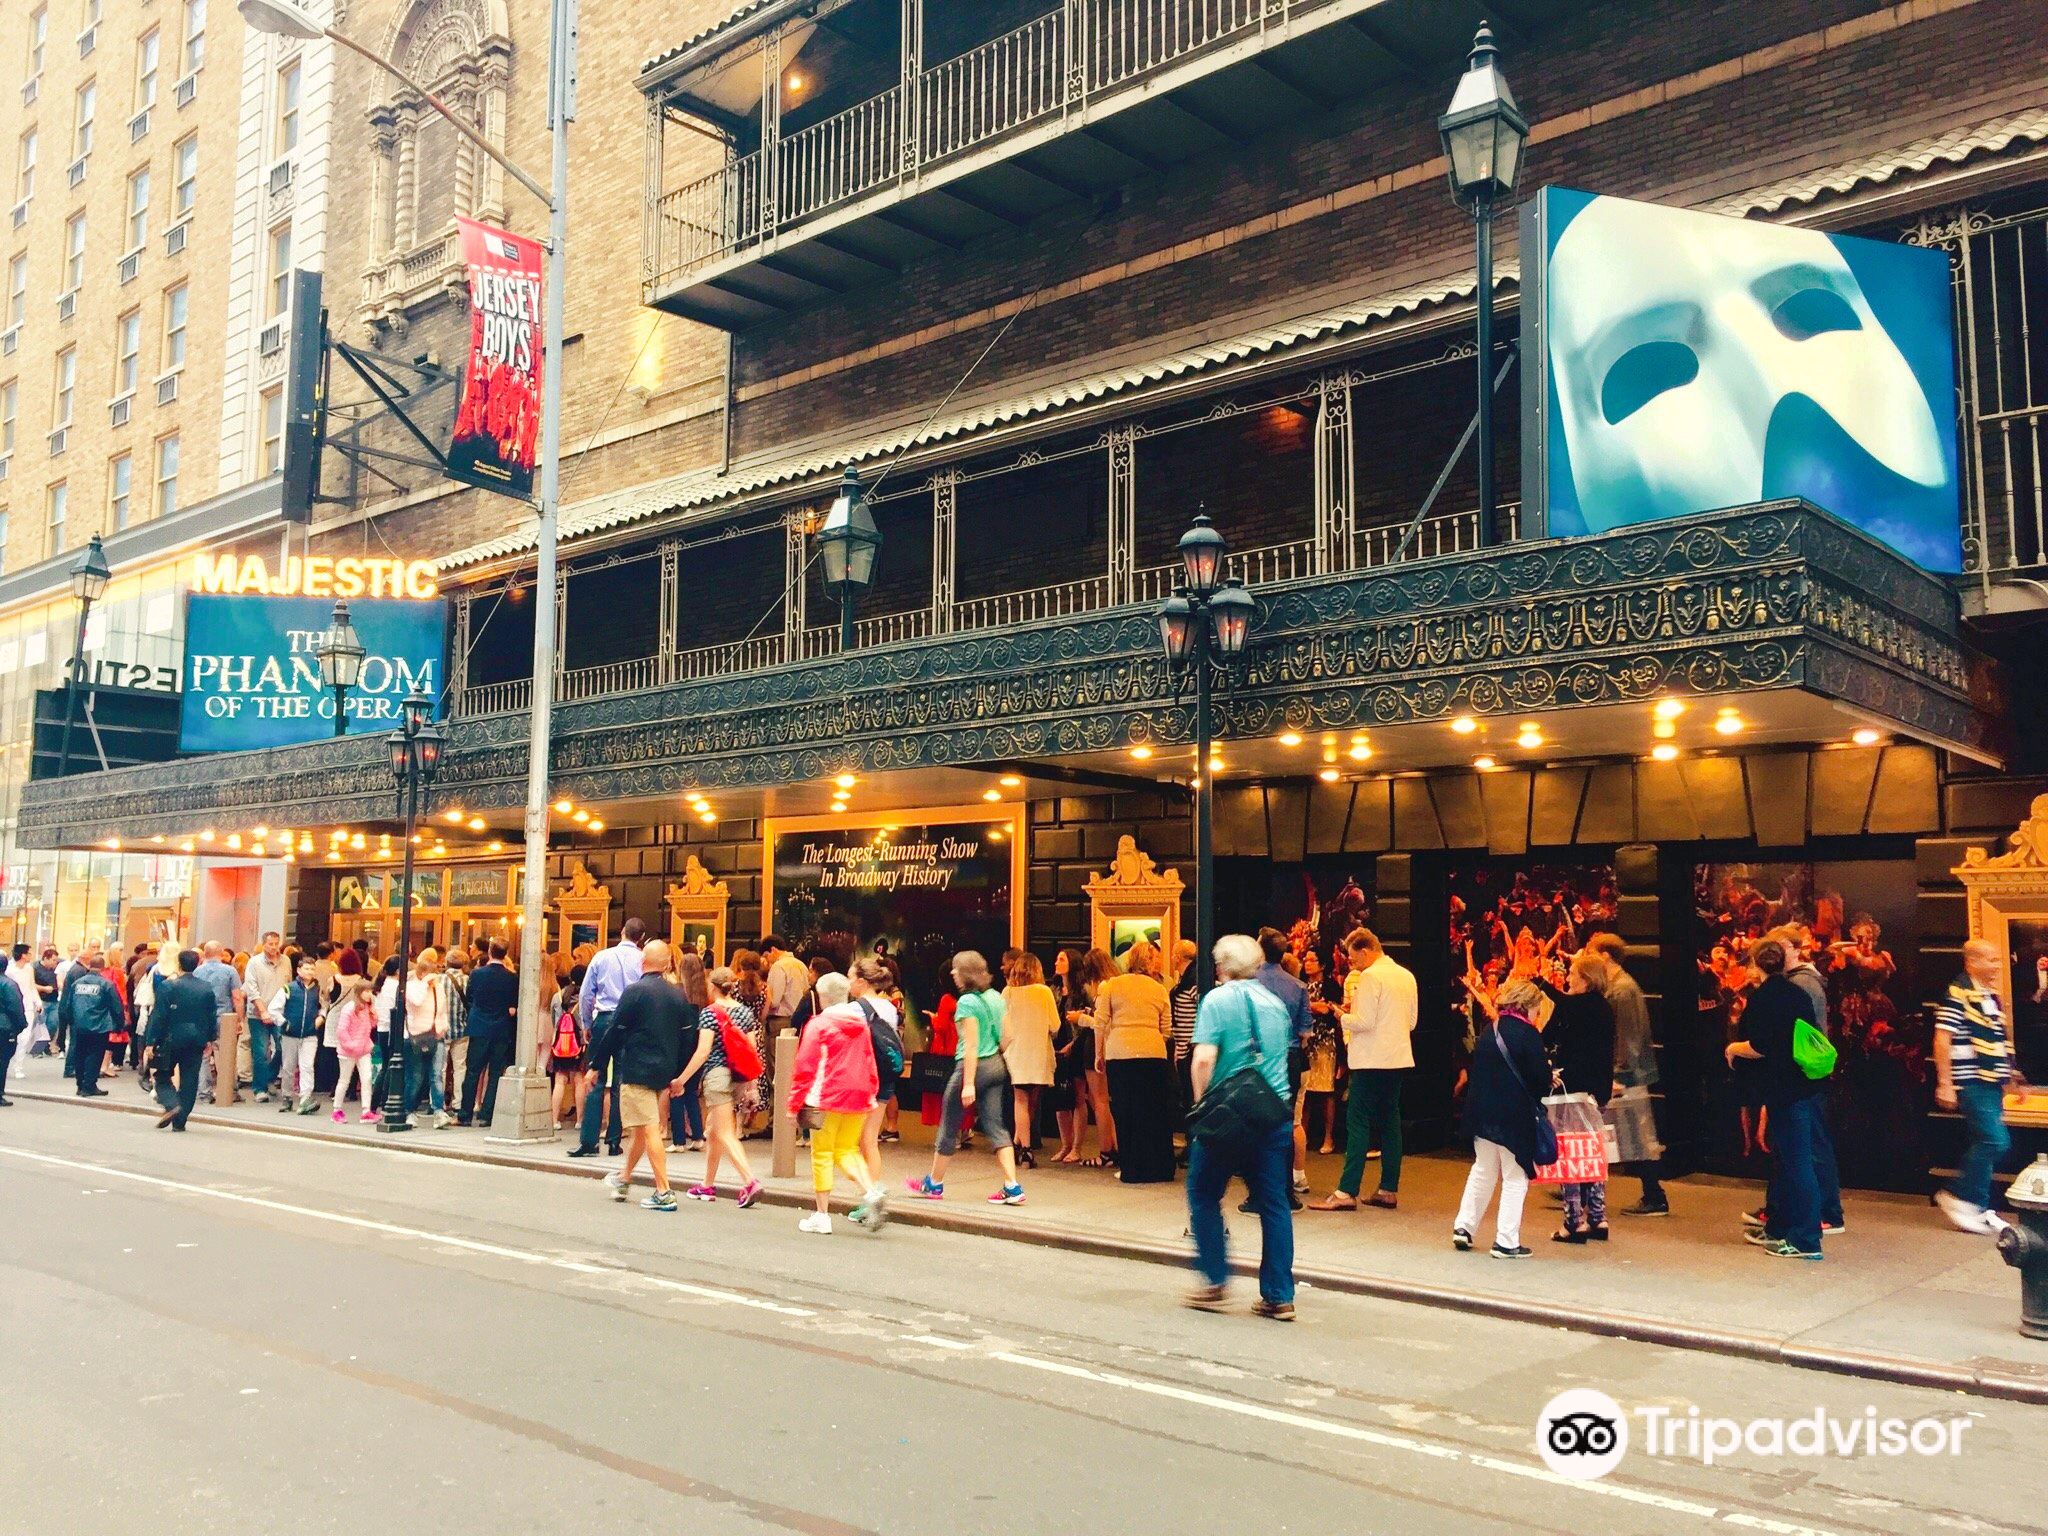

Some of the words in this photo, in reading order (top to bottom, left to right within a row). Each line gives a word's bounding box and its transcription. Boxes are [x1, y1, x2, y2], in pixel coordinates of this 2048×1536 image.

[473, 272, 540, 323] JERSEY
[482, 313, 531, 372] BOYS
[192, 553, 438, 599] MAJESTIC
[286, 630, 345, 653] THE
[205, 696, 243, 719] OF
[251, 696, 310, 719] THE
[802, 843, 824, 863] The
[826, 840, 938, 868] Longest-Running
[940, 837, 978, 859] Show
[820, 867, 834, 887] In
[836, 864, 900, 892] Broadway
[902, 864, 953, 891] History
[1567, 1158, 1604, 1178] MET
